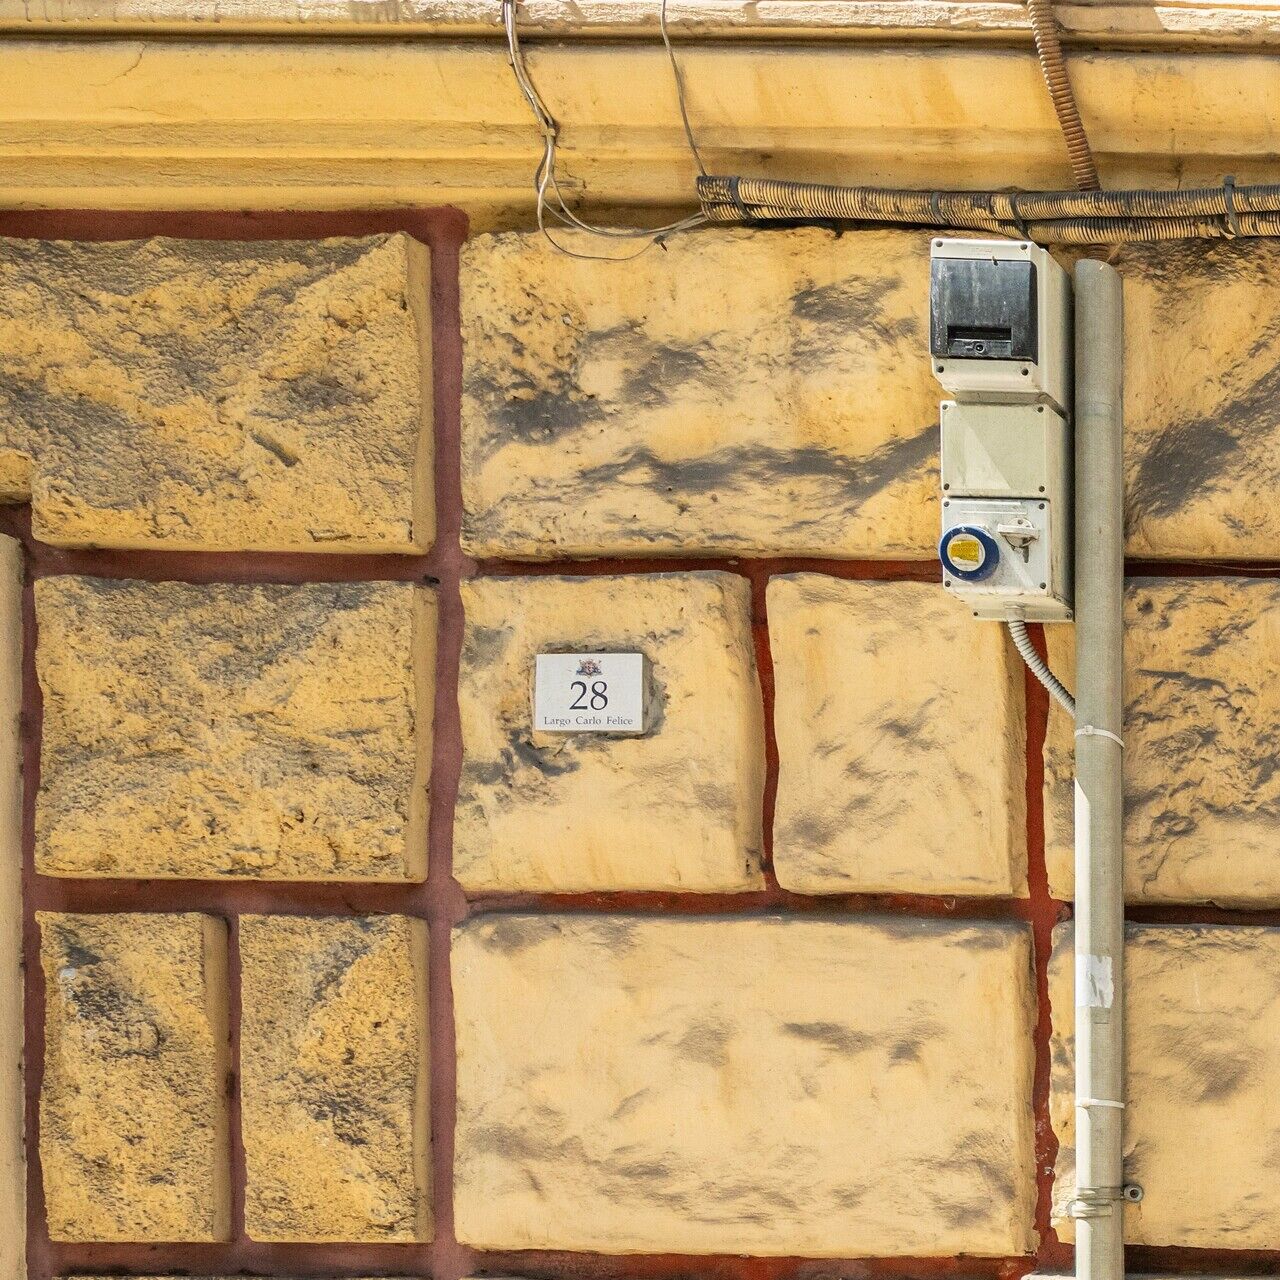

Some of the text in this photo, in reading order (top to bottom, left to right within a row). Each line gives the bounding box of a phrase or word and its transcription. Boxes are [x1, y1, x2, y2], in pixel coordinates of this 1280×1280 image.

[569, 680, 609, 711] 28
[544, 716, 633, 727] Largo Carlo Felice
